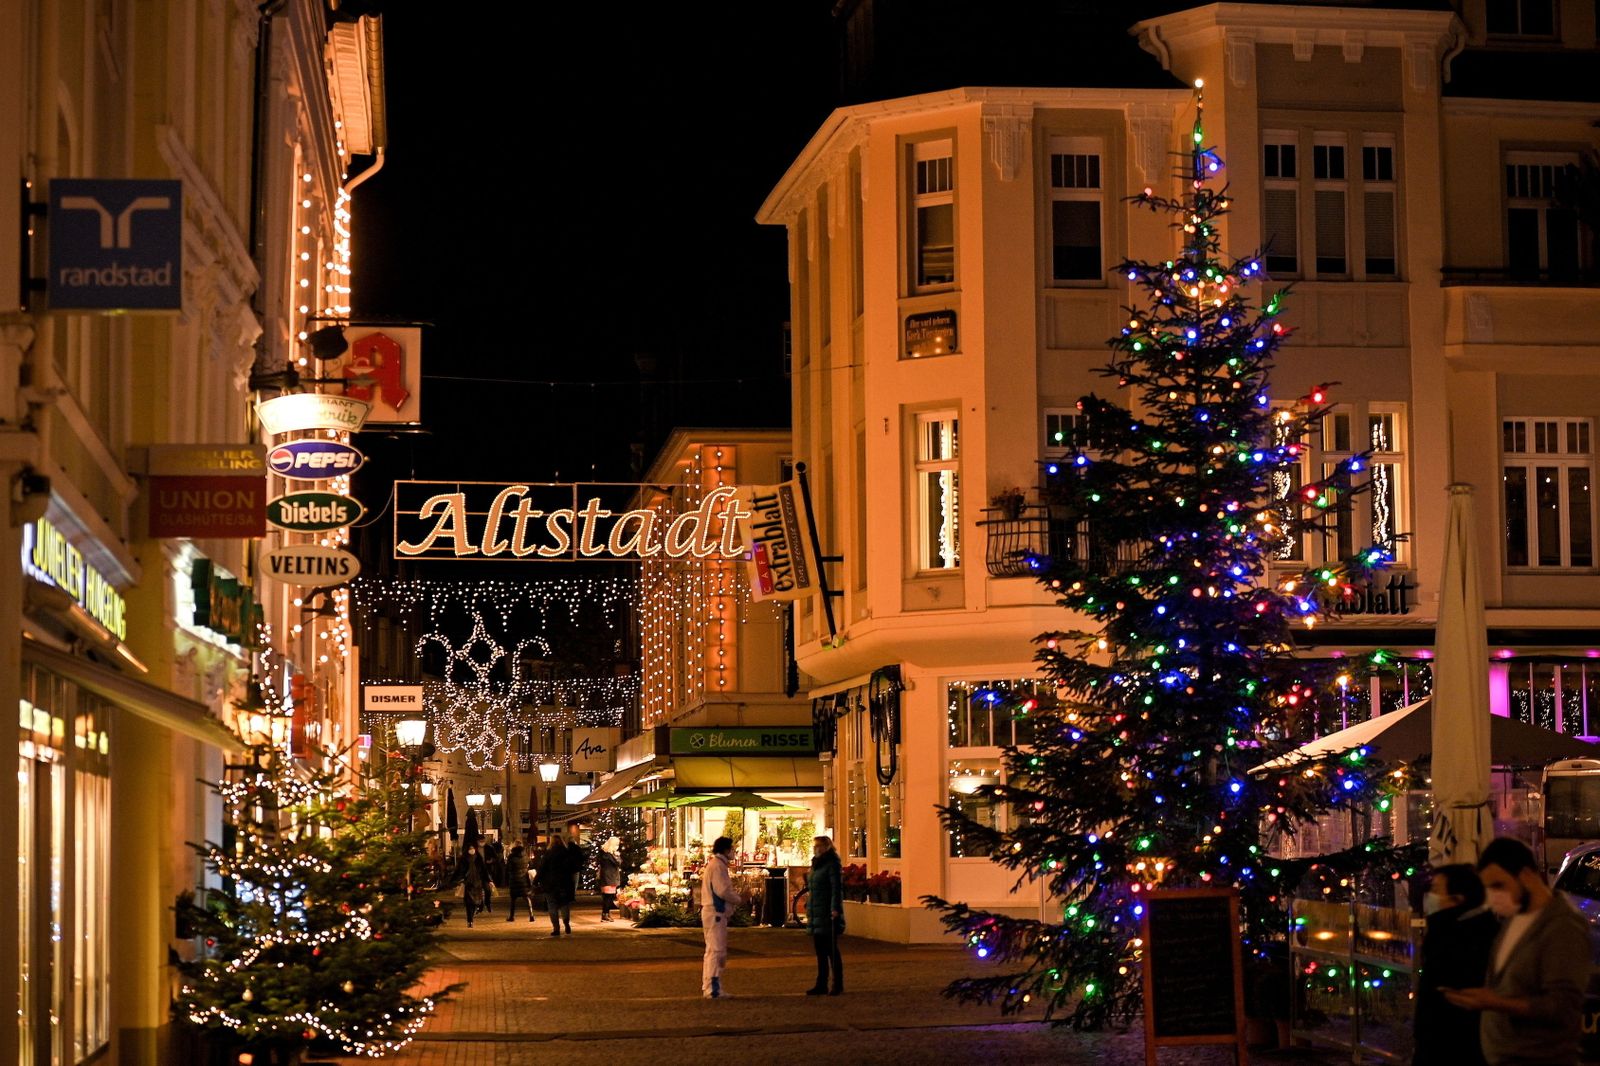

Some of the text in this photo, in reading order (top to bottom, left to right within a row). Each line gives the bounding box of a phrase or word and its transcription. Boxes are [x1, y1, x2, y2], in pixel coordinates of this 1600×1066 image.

[60, 261, 171, 287] randstad
[295, 452, 356, 468] PEPSI
[160, 490, 256, 509] UNION
[396, 485, 752, 556] Altstadt
[749, 492, 795, 592] extrablatt
[270, 555, 350, 576] VELTINS
[371, 695, 416, 703] DISMER
[575, 737, 606, 760] Ava
[709, 732, 809, 748] Blumen RISSE
